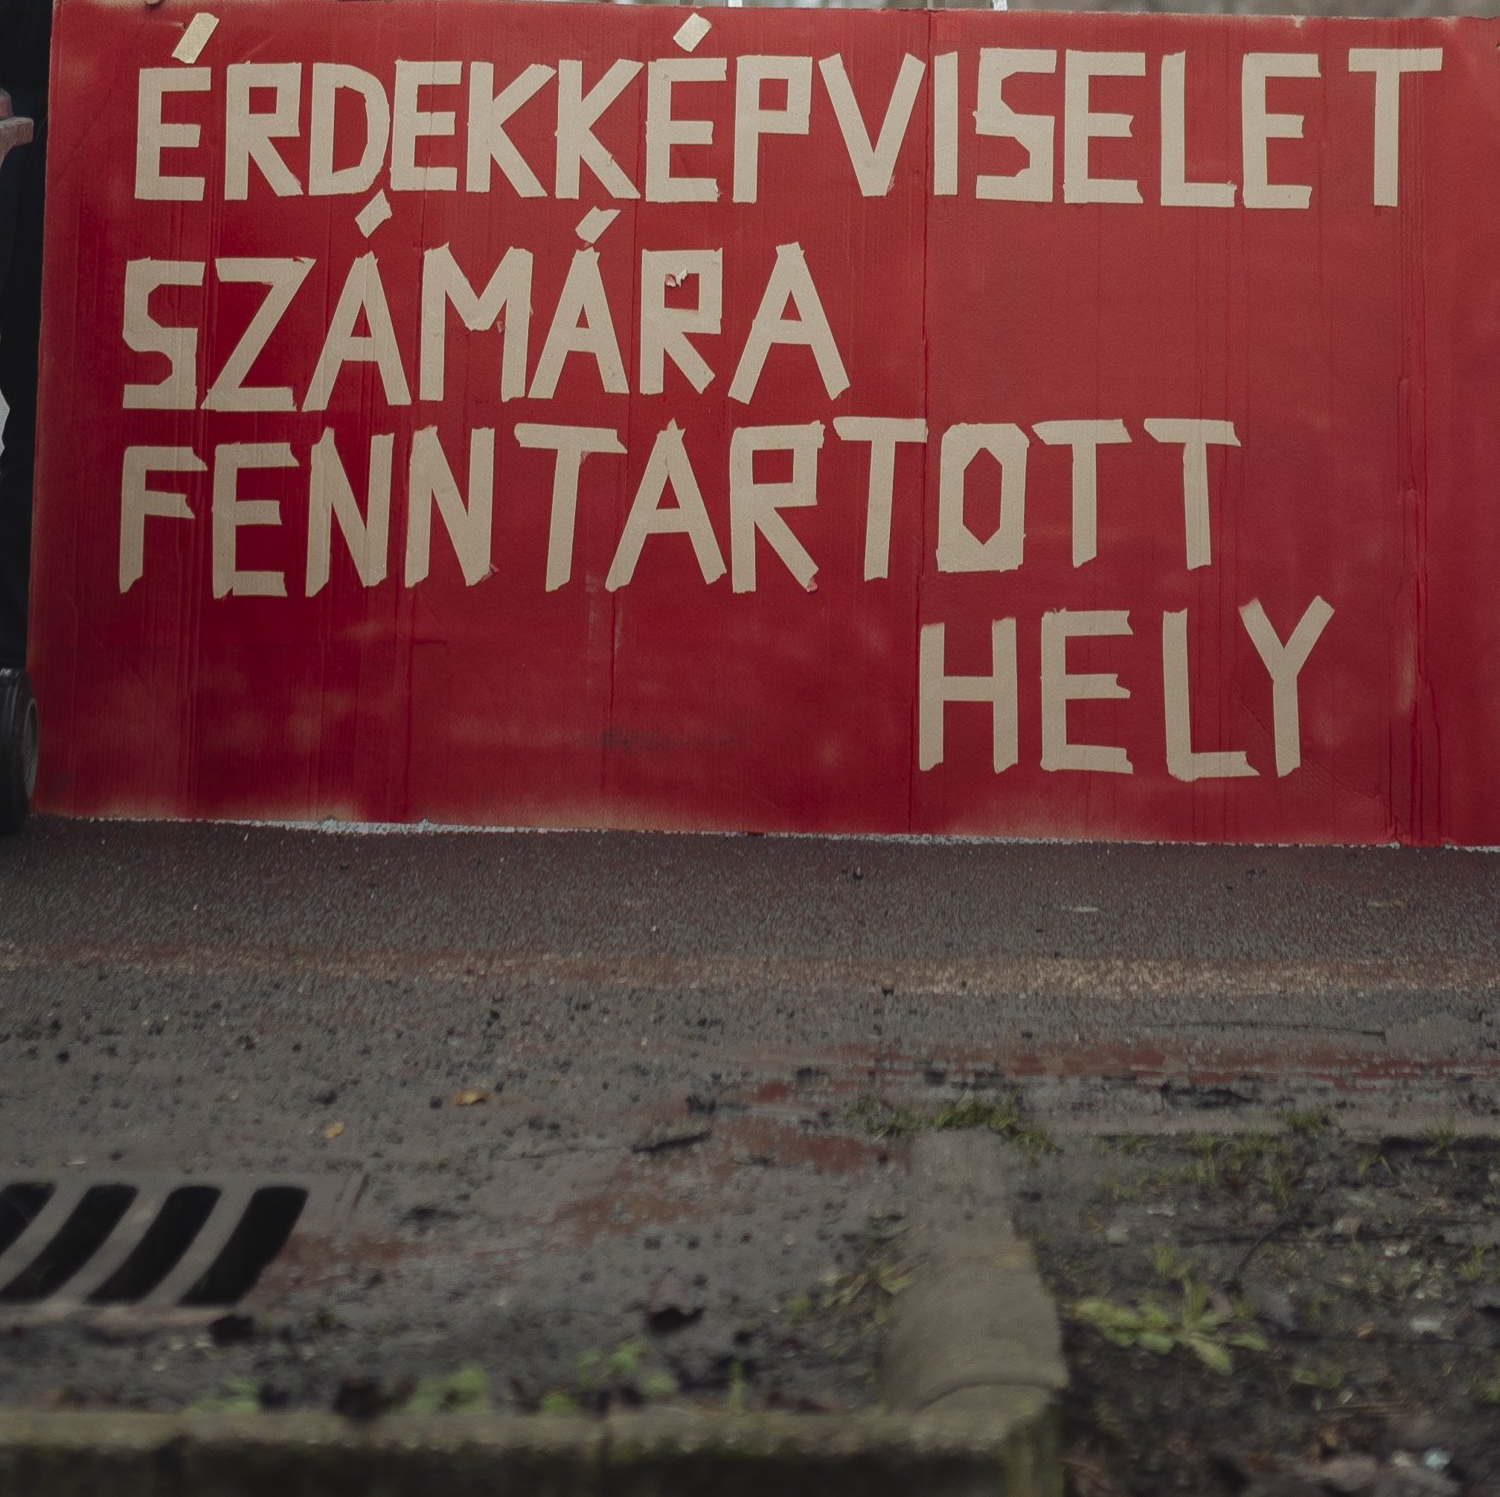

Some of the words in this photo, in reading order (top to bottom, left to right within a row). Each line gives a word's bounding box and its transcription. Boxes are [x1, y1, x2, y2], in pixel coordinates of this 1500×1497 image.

[134, 12, 1444, 208] ÉRDEKKÉPVISELET
[121, 189, 851, 412] SZÁMÁRA
[118, 415, 1242, 599] FENNTARTOTT
[918, 595, 1335, 782] HELY
